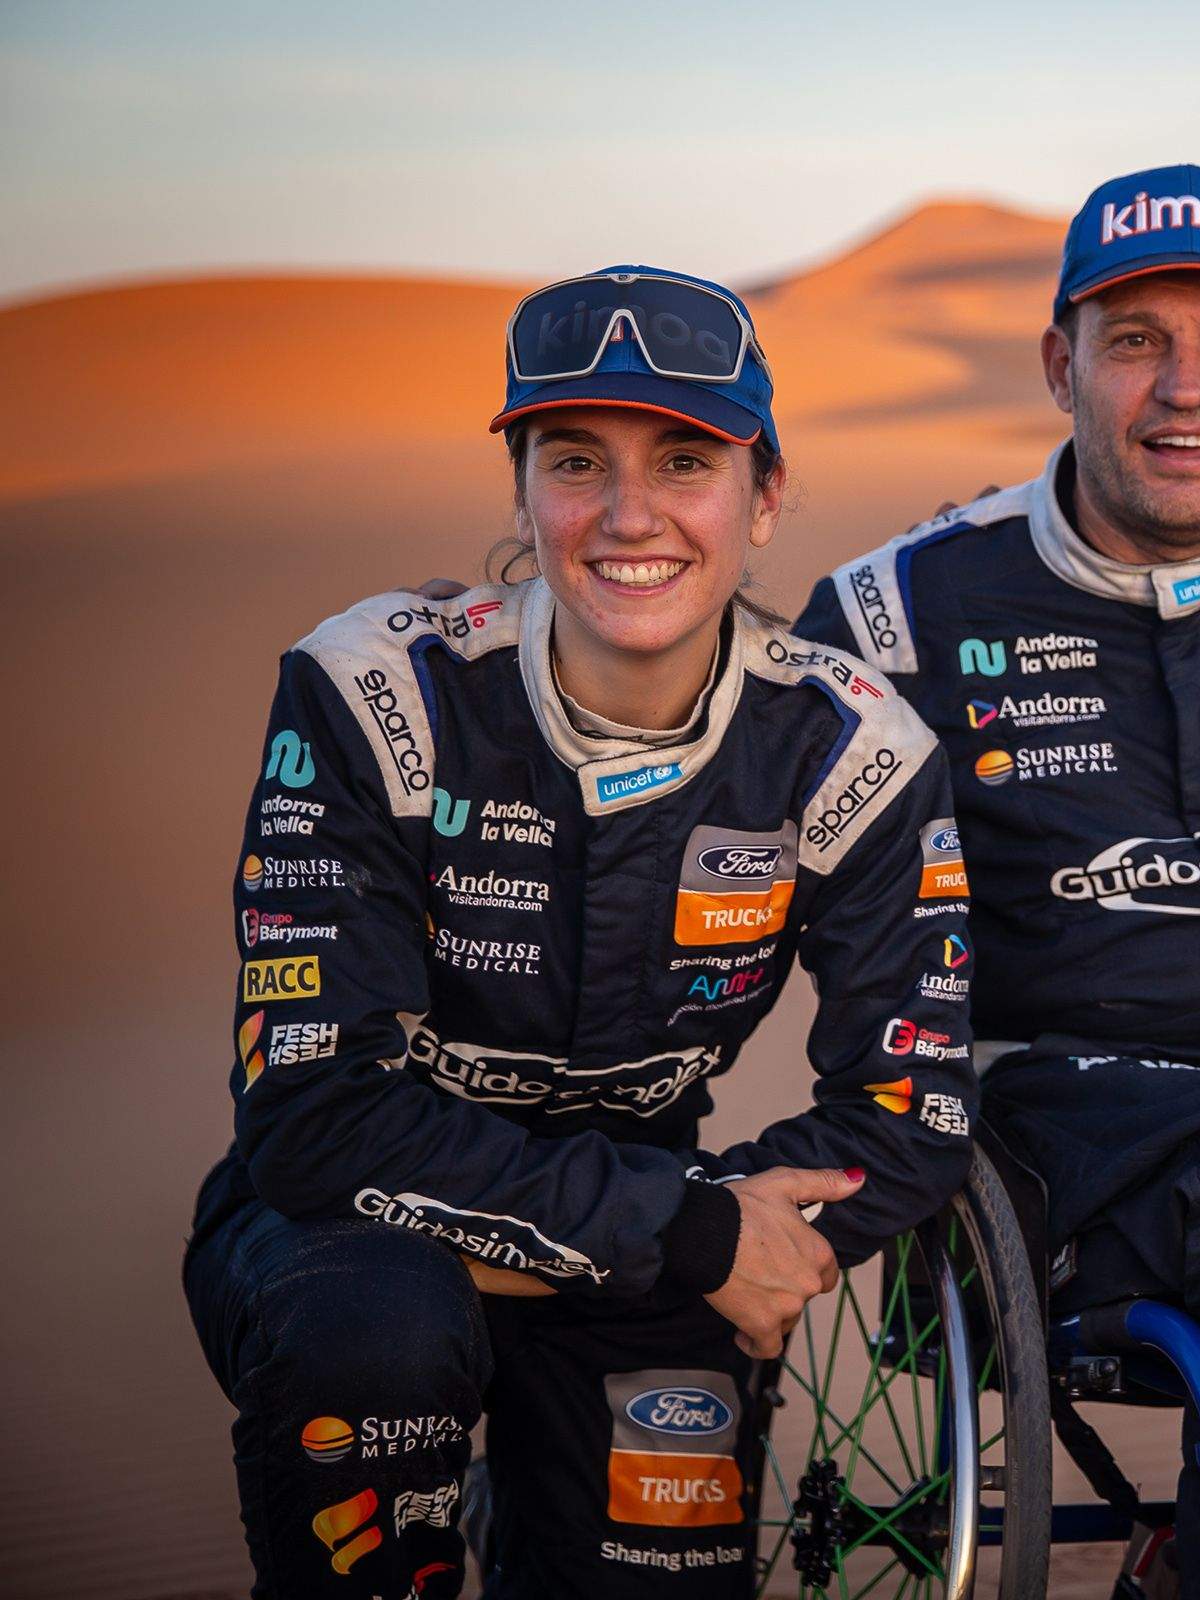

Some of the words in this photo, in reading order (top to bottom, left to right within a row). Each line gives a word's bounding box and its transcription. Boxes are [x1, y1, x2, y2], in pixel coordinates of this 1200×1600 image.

[850, 564, 898, 653] sparco
[1015, 632, 1098, 654] Andorra
[1020, 656, 1042, 674] la
[1044, 650, 1097, 671] Vella
[998, 692, 1107, 719] Andorra
[354, 669, 430, 796] sparco
[1016, 743, 1115, 769] SUNRISE
[604, 768, 653, 796] unicef
[806, 748, 903, 853] sparco
[261, 819, 273, 836] la
[273, 816, 314, 835] Vella
[481, 822, 500, 840] la
[503, 823, 553, 848] Vella
[264, 856, 344, 876] SUNRISE
[718, 849, 778, 875] Ford
[435, 865, 550, 901] Andorra
[448, 892, 543, 912] visitandorra.com
[260, 924, 338, 943] Bárymont
[436, 928, 541, 960] SUNRISE
[247, 961, 316, 997] RACC
[271, 1022, 339, 1046] FESH
[918, 1028, 950, 1045] Grupo
[650, 1392, 717, 1428] Ford
[601, 1541, 682, 1572] Sharing
[684, 1547, 716, 1567] the
[717, 1545, 745, 1563] loa
